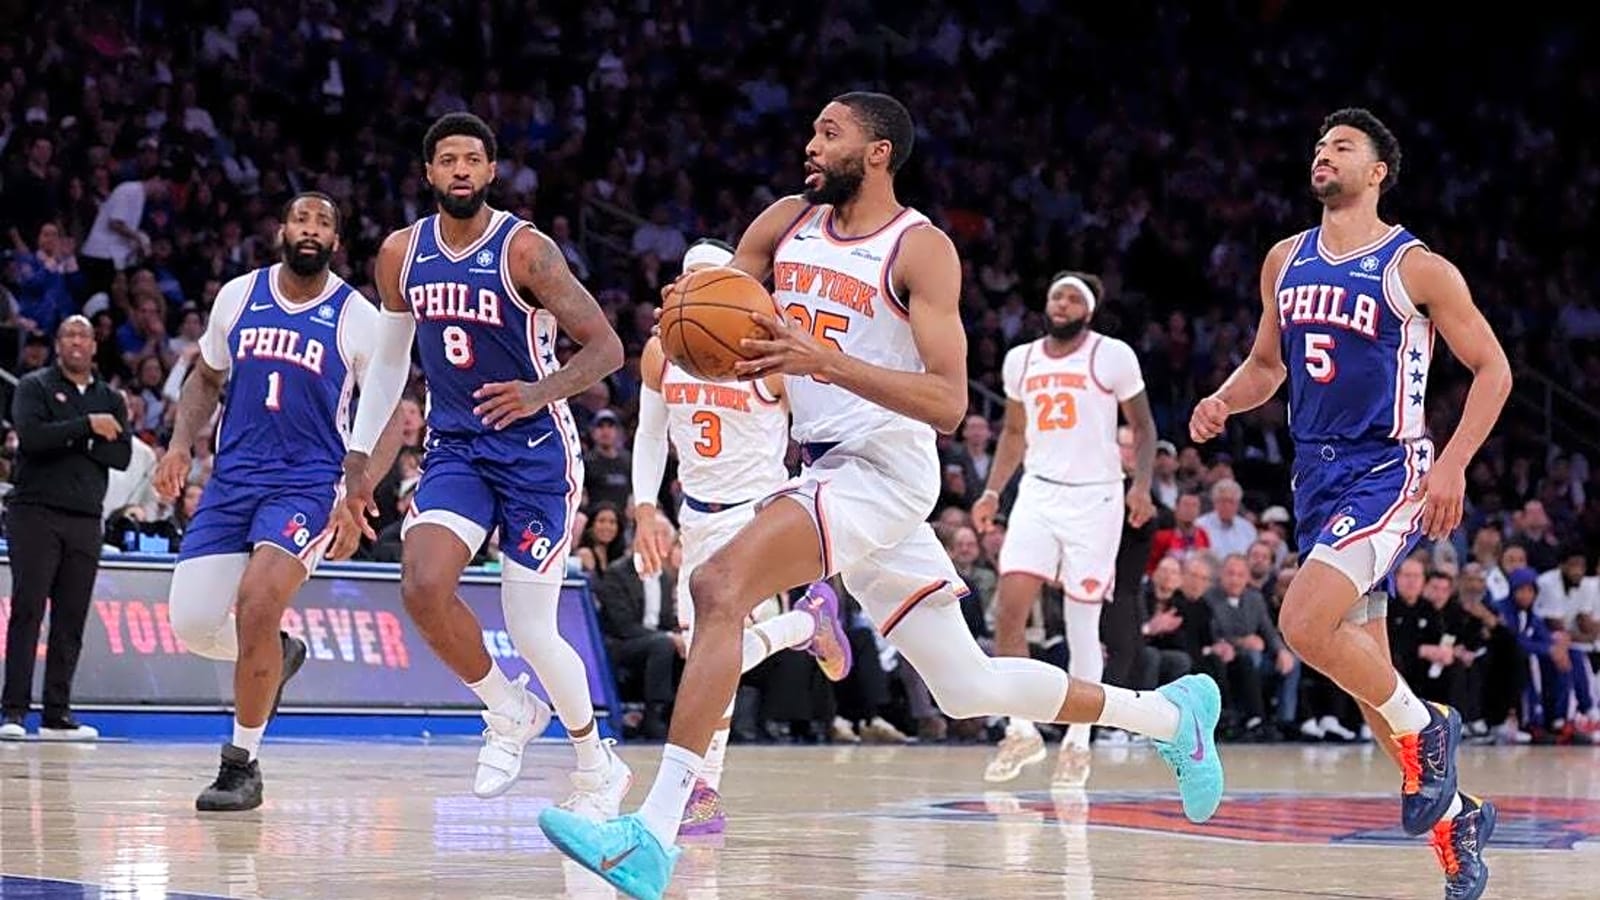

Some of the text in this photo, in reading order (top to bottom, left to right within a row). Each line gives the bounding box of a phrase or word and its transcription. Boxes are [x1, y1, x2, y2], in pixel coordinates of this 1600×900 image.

[408, 282, 504, 328] PHILA
[817, 267, 878, 319] YORK
[1278, 284, 1379, 343] PHILA
[236, 326, 326, 376] PHILA
[443, 325, 476, 369] 8
[1304, 332, 1336, 384] 5
[265, 371, 282, 412] 1
[664, 382, 751, 413] NEW YORK
[1035, 393, 1076, 431] 23
[692, 410, 722, 458] 3
[94, 600, 189, 655] YOR
[279, 606, 411, 669] REVER
